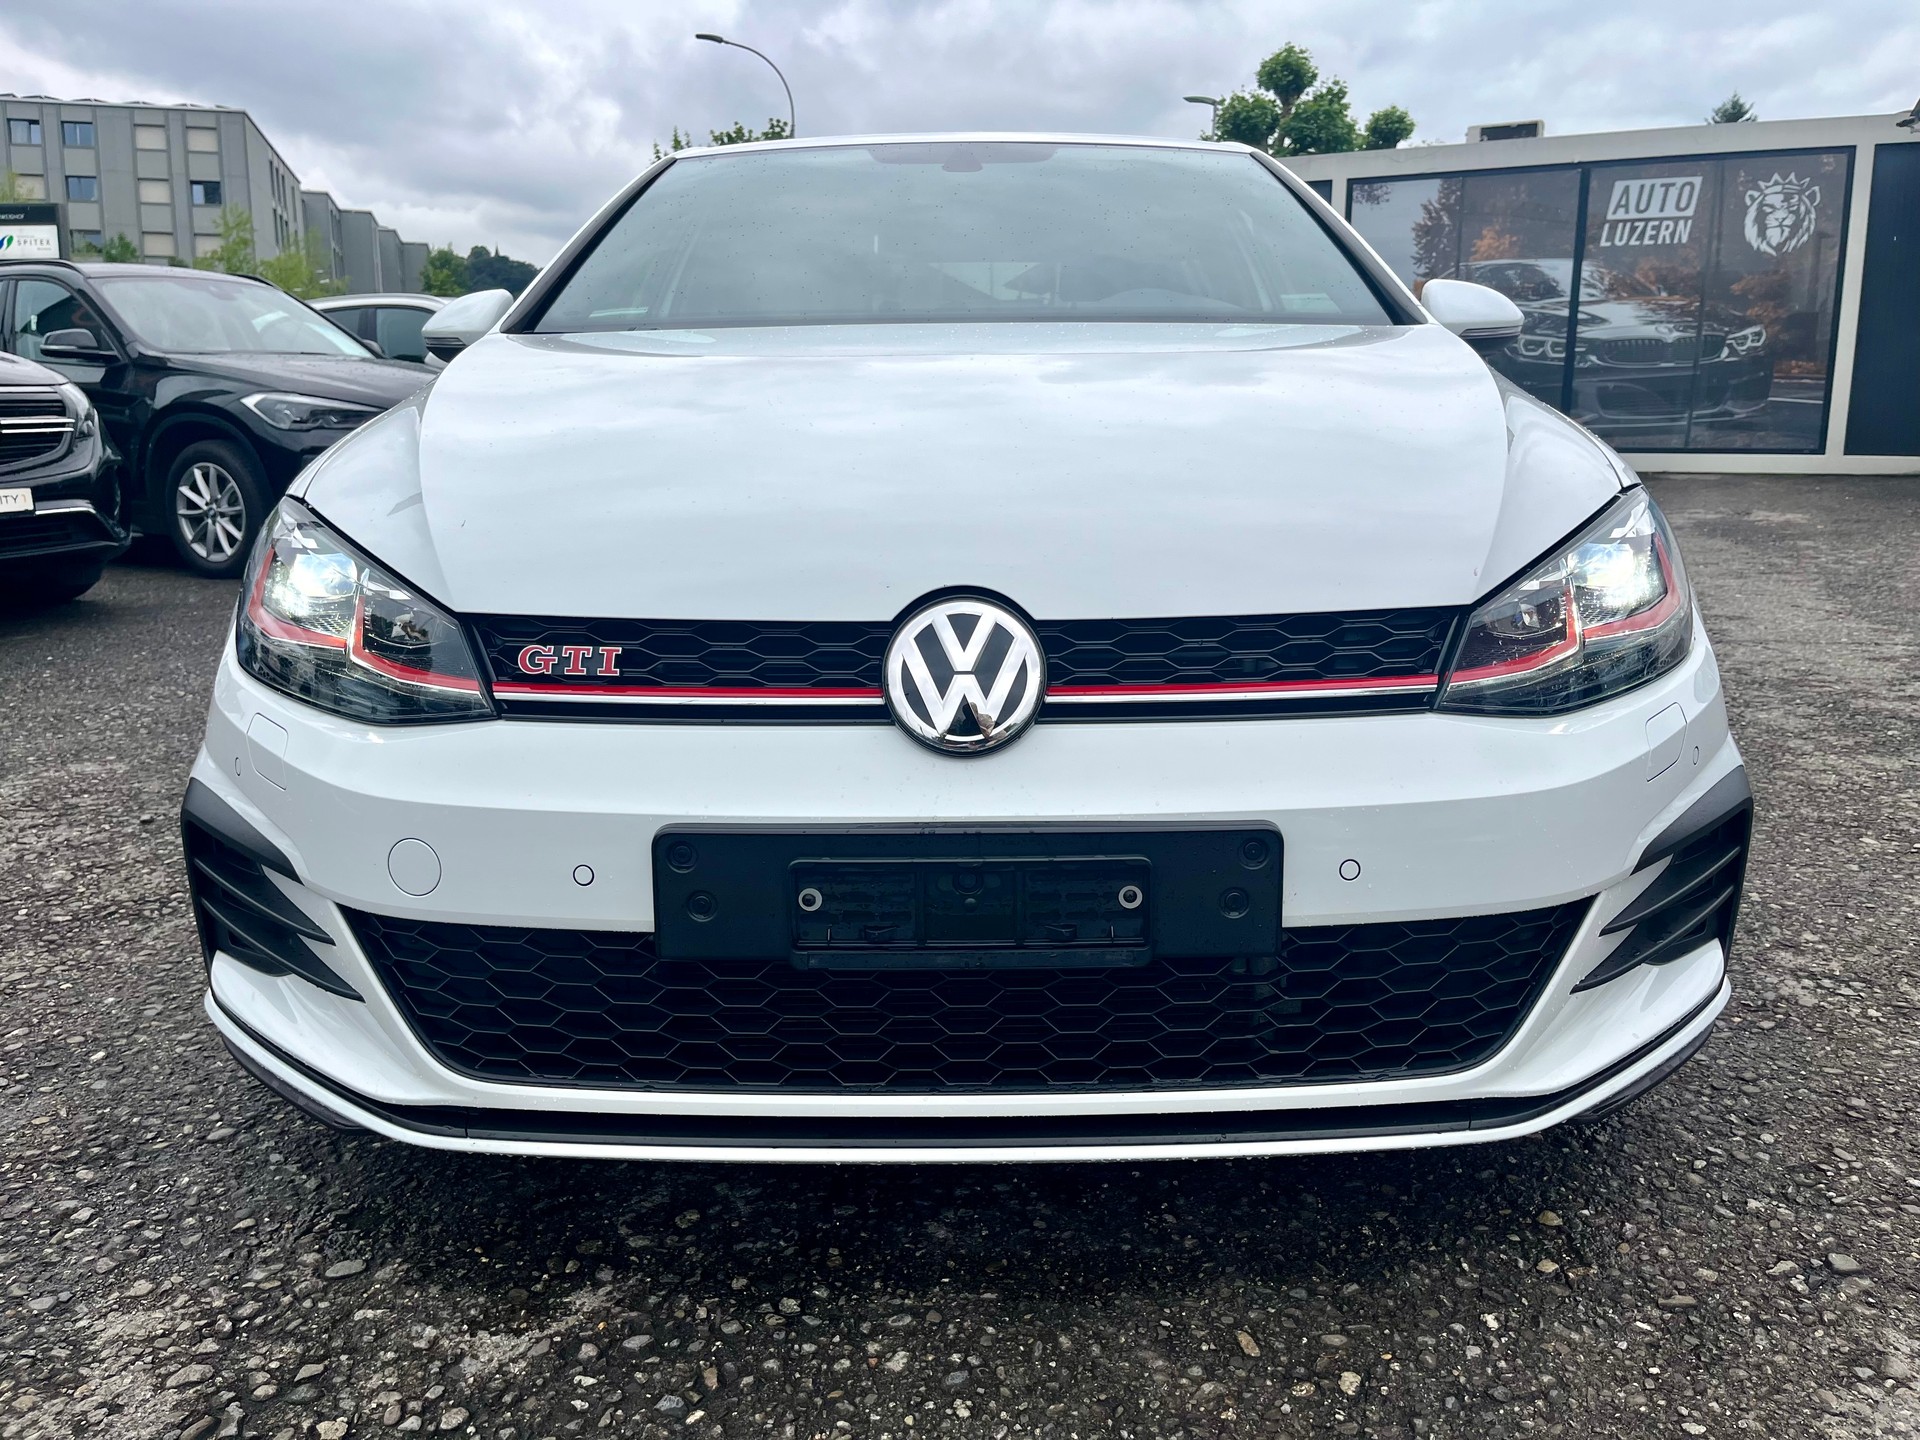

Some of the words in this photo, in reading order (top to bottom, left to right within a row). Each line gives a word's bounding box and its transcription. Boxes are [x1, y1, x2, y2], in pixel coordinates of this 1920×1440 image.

[1612, 181, 1696, 215] AUTO
[1600, 219, 1693, 247] LUZERN
[518, 645, 622, 675] GTI
[895, 603, 1033, 745] VW
